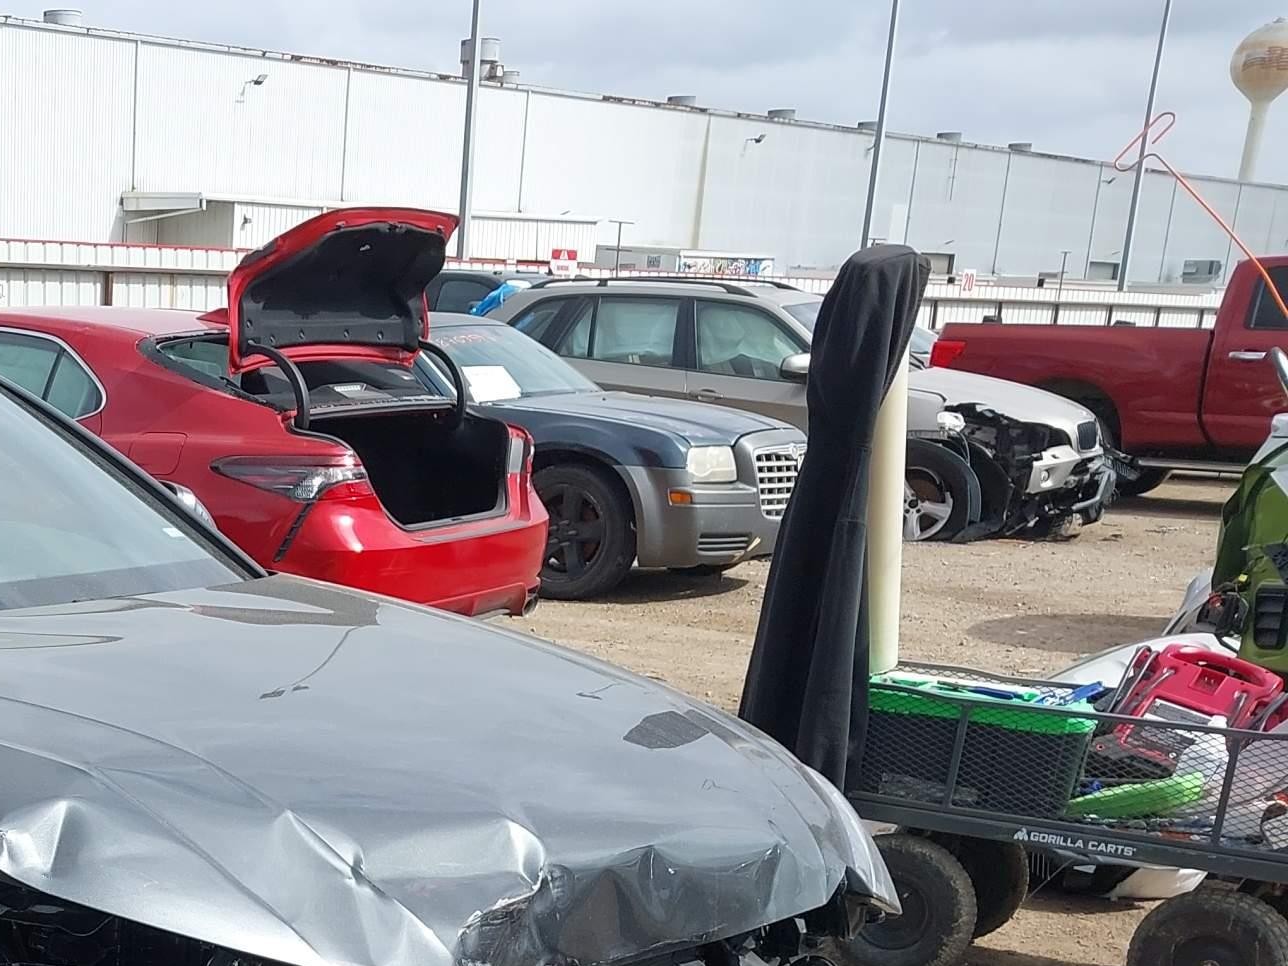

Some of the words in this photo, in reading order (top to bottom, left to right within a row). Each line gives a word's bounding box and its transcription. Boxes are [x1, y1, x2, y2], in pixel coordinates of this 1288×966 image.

[962, 272, 974, 291] 20
[1030, 831, 1084, 848] GORILLA
[1088, 841, 1134, 856] CARTS
